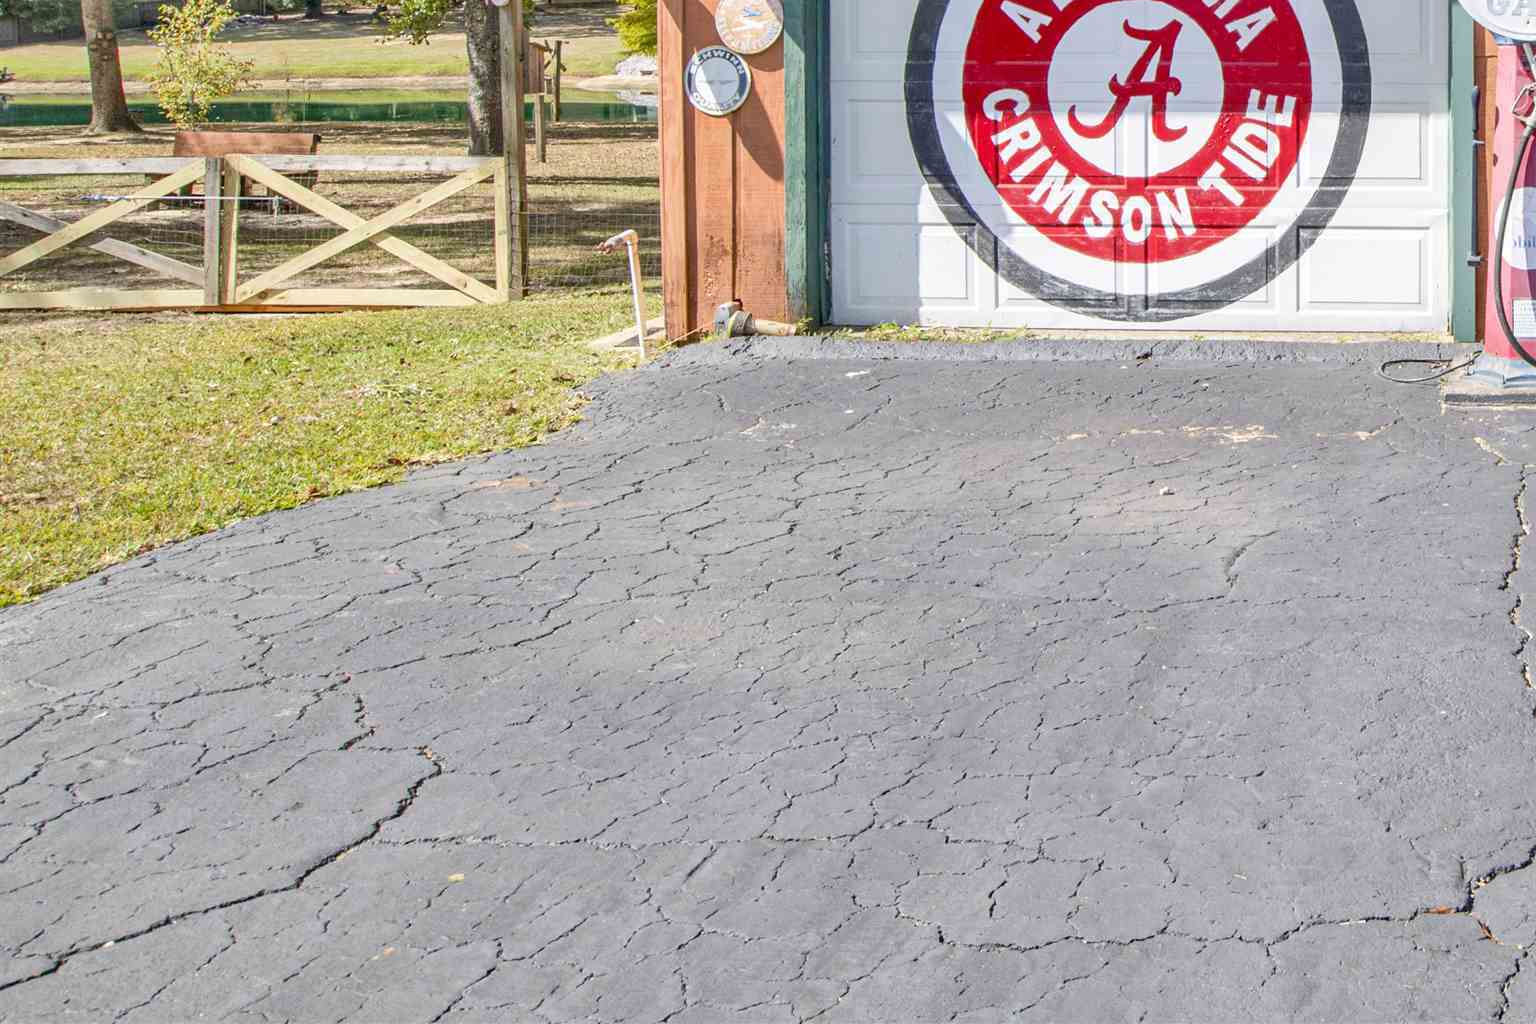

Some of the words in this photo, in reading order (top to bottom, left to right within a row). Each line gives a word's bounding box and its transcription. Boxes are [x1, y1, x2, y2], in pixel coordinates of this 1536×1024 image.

[1067, 18, 1188, 142] A
[982, 87, 1198, 243] CRIMSON
[1199, 88, 1297, 208] TIDE
